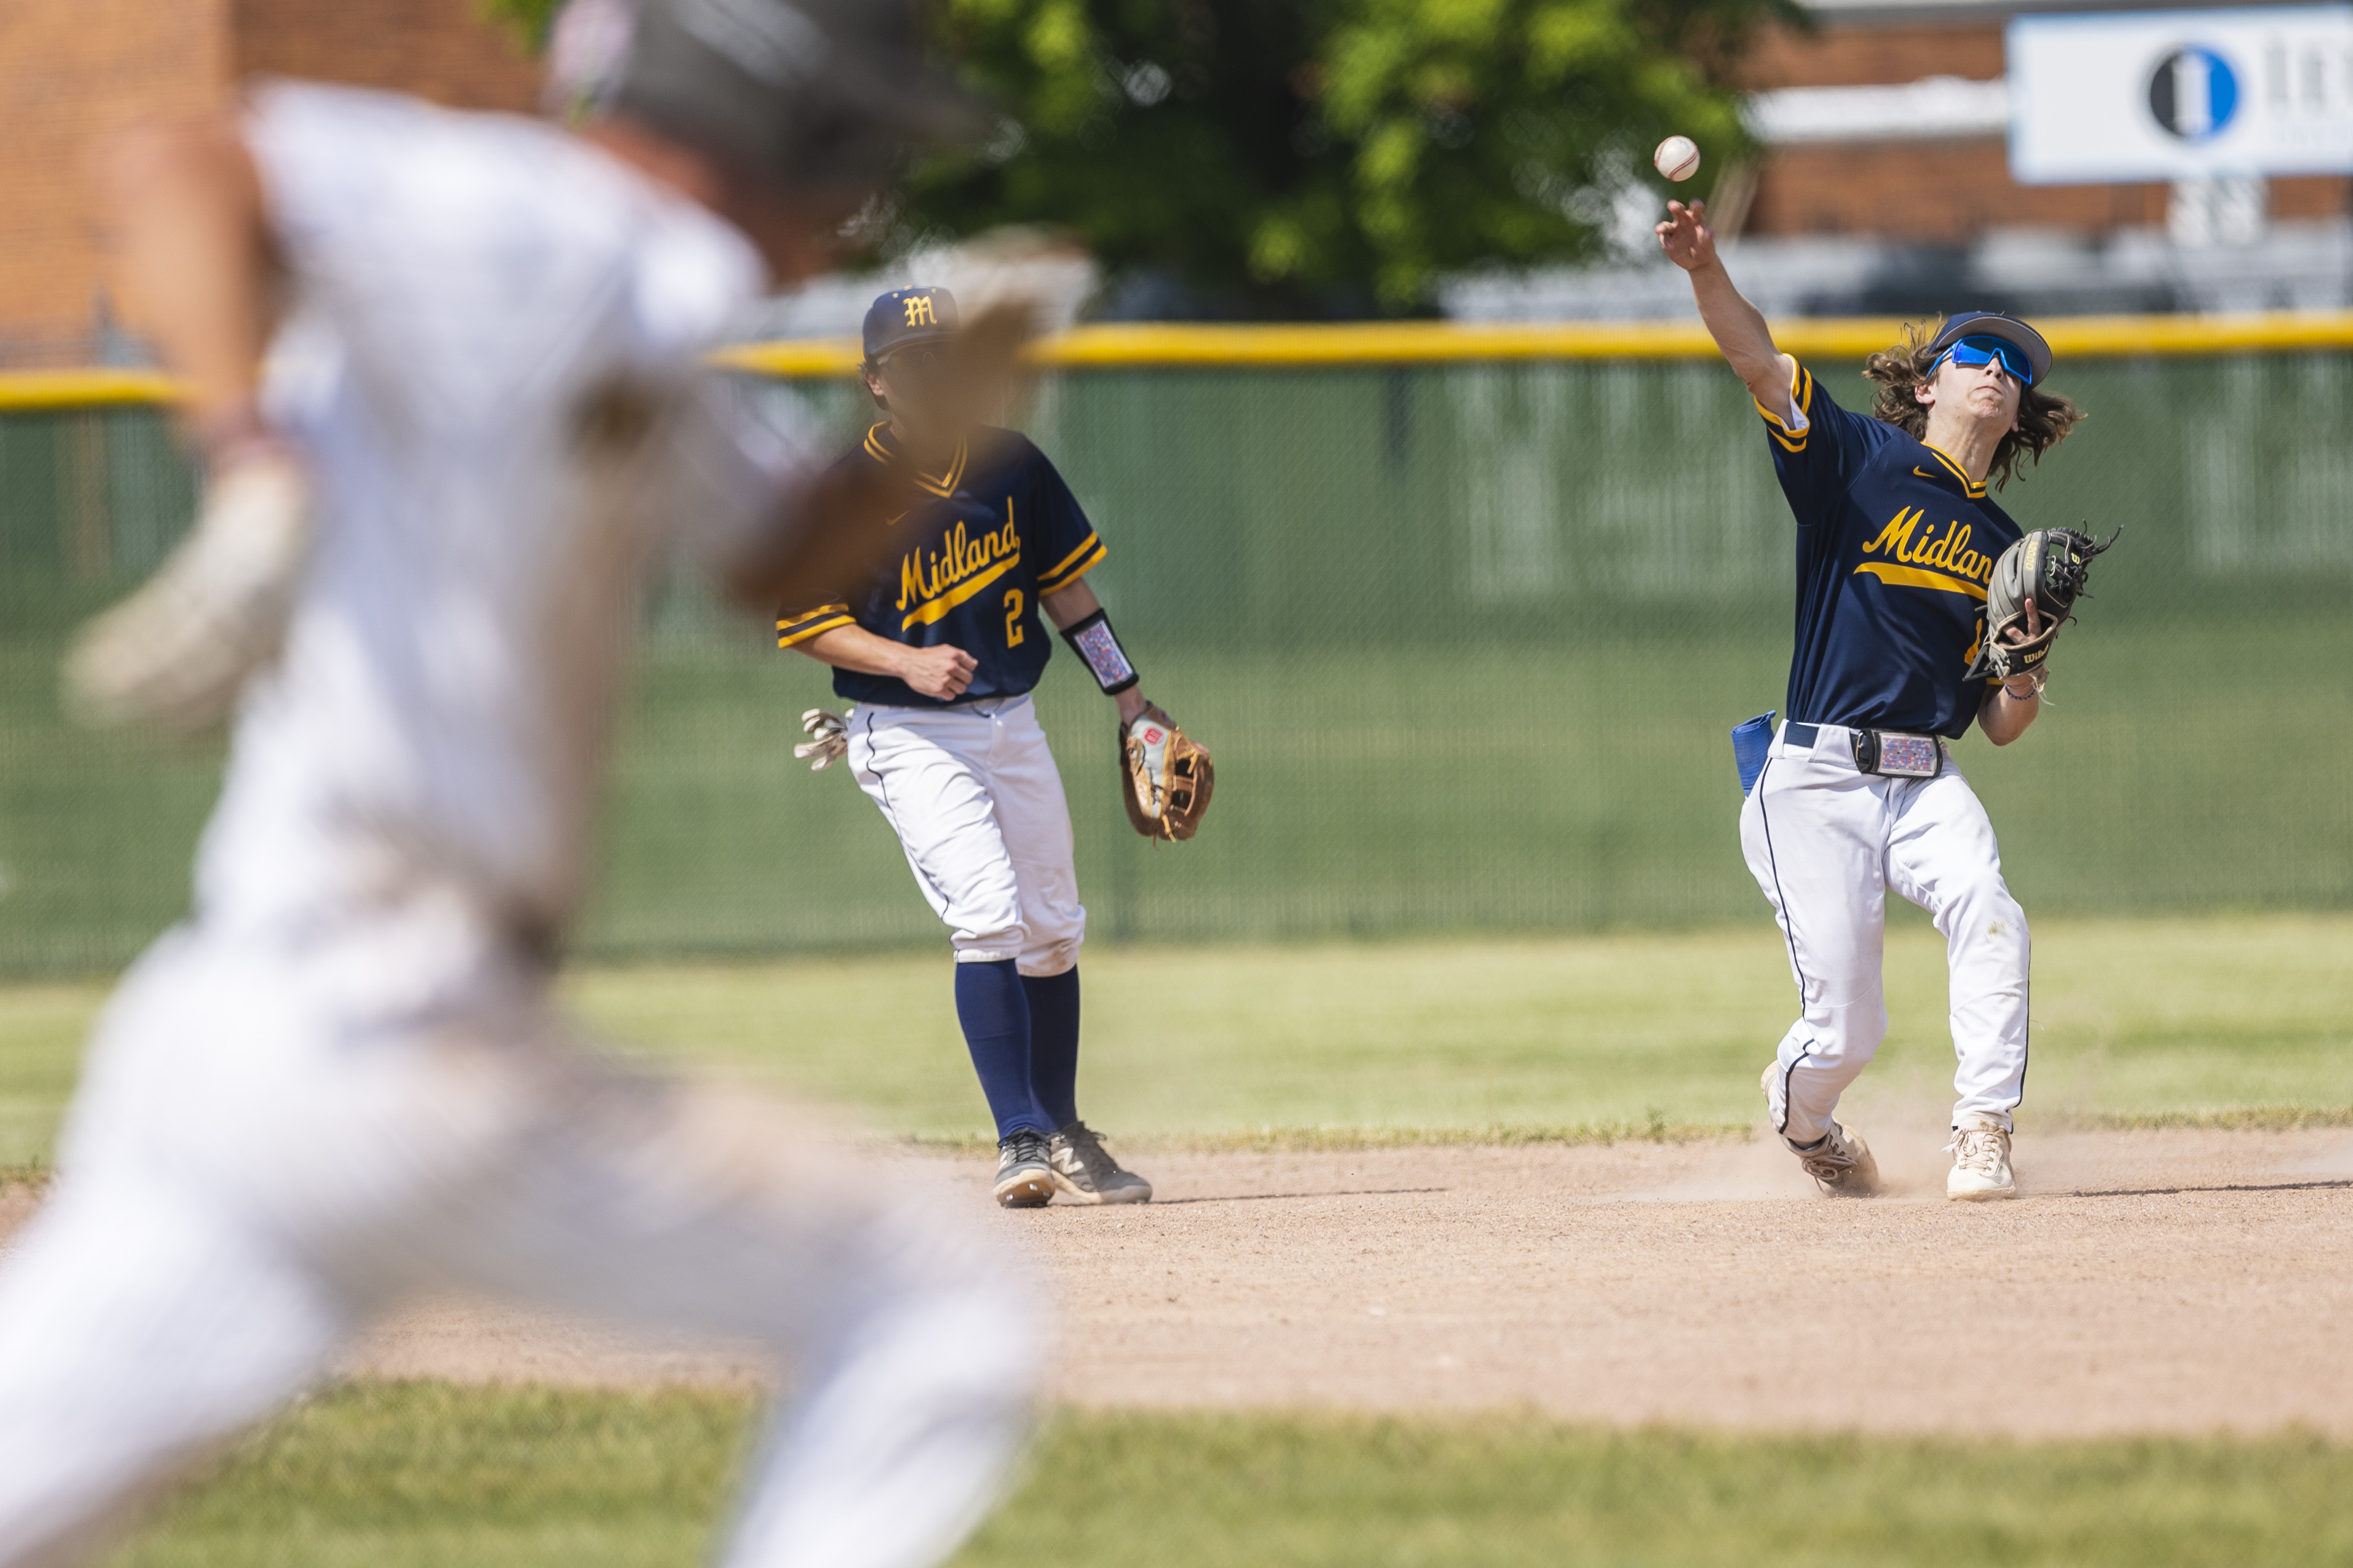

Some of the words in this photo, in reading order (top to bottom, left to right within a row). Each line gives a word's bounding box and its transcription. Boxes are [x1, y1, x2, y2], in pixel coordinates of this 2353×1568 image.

[903, 296, 938, 327] M
[896, 496, 1021, 611] Midland
[1862, 505, 1992, 585] Midlan
[1004, 588, 1024, 649] 2
